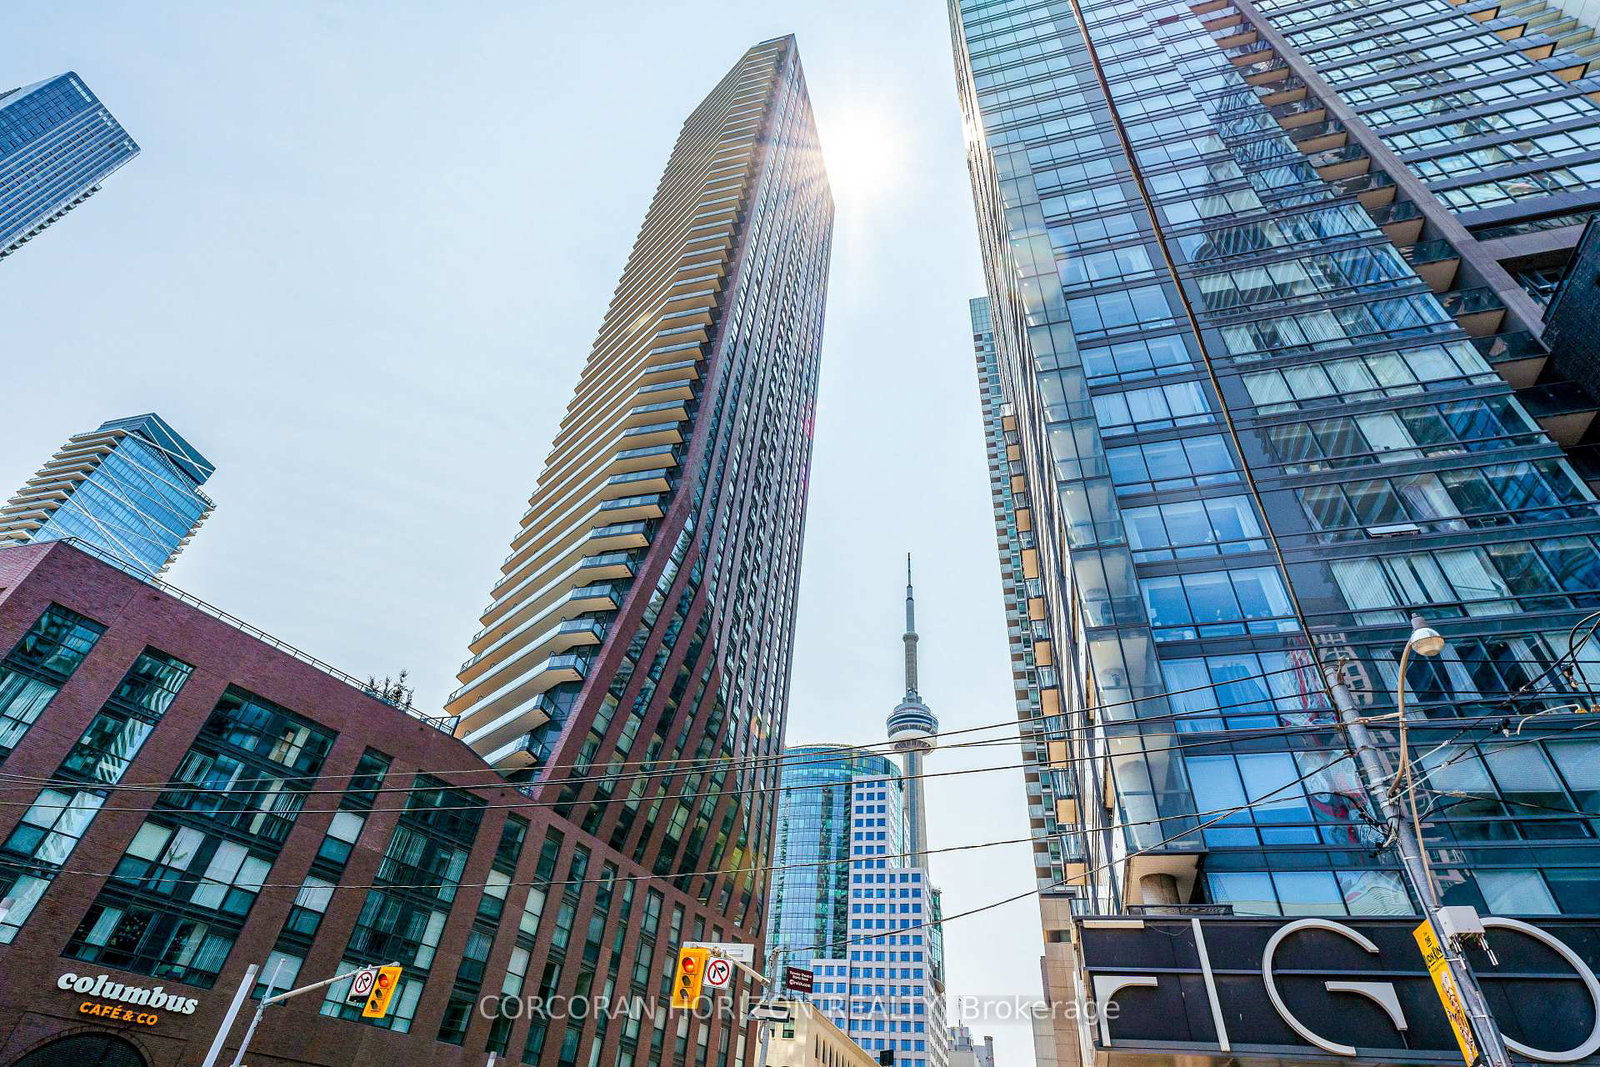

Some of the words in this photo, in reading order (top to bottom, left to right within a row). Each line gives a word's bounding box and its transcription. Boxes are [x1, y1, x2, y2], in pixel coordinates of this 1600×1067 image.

[57, 972, 199, 1015] columbus
[1083, 916, 1600, 1062] FIGO
[79, 1001, 123, 1020] CAFÉ
[122, 1010, 134, 1022] &
[136, 1013, 159, 1026] CO
